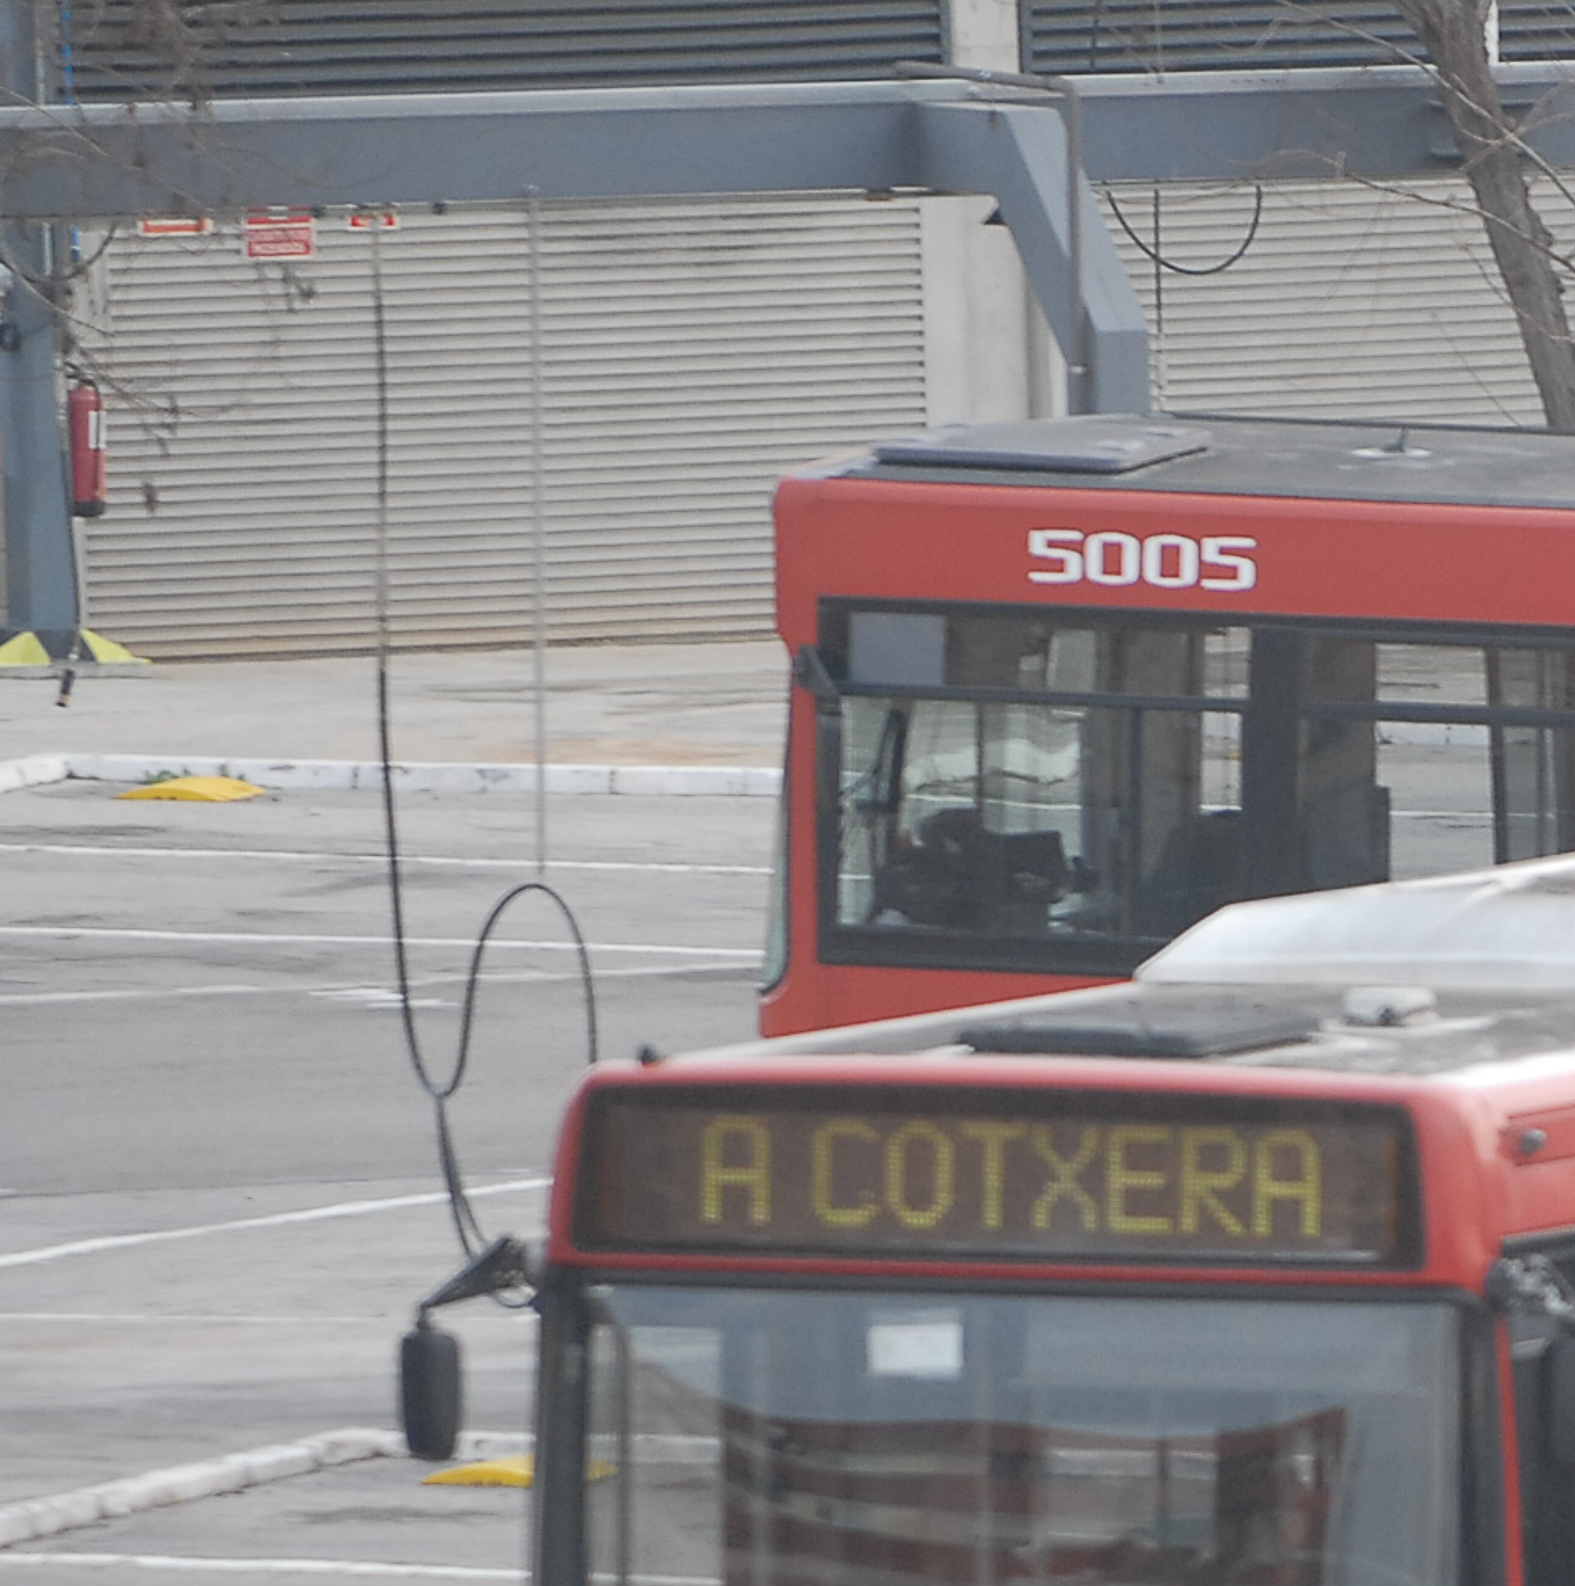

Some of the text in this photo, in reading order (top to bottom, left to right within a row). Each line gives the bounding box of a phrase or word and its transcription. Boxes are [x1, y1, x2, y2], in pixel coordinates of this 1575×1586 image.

[1027, 529, 1257, 591] 5005
[703, 1117, 1321, 1238] A COTXERA
